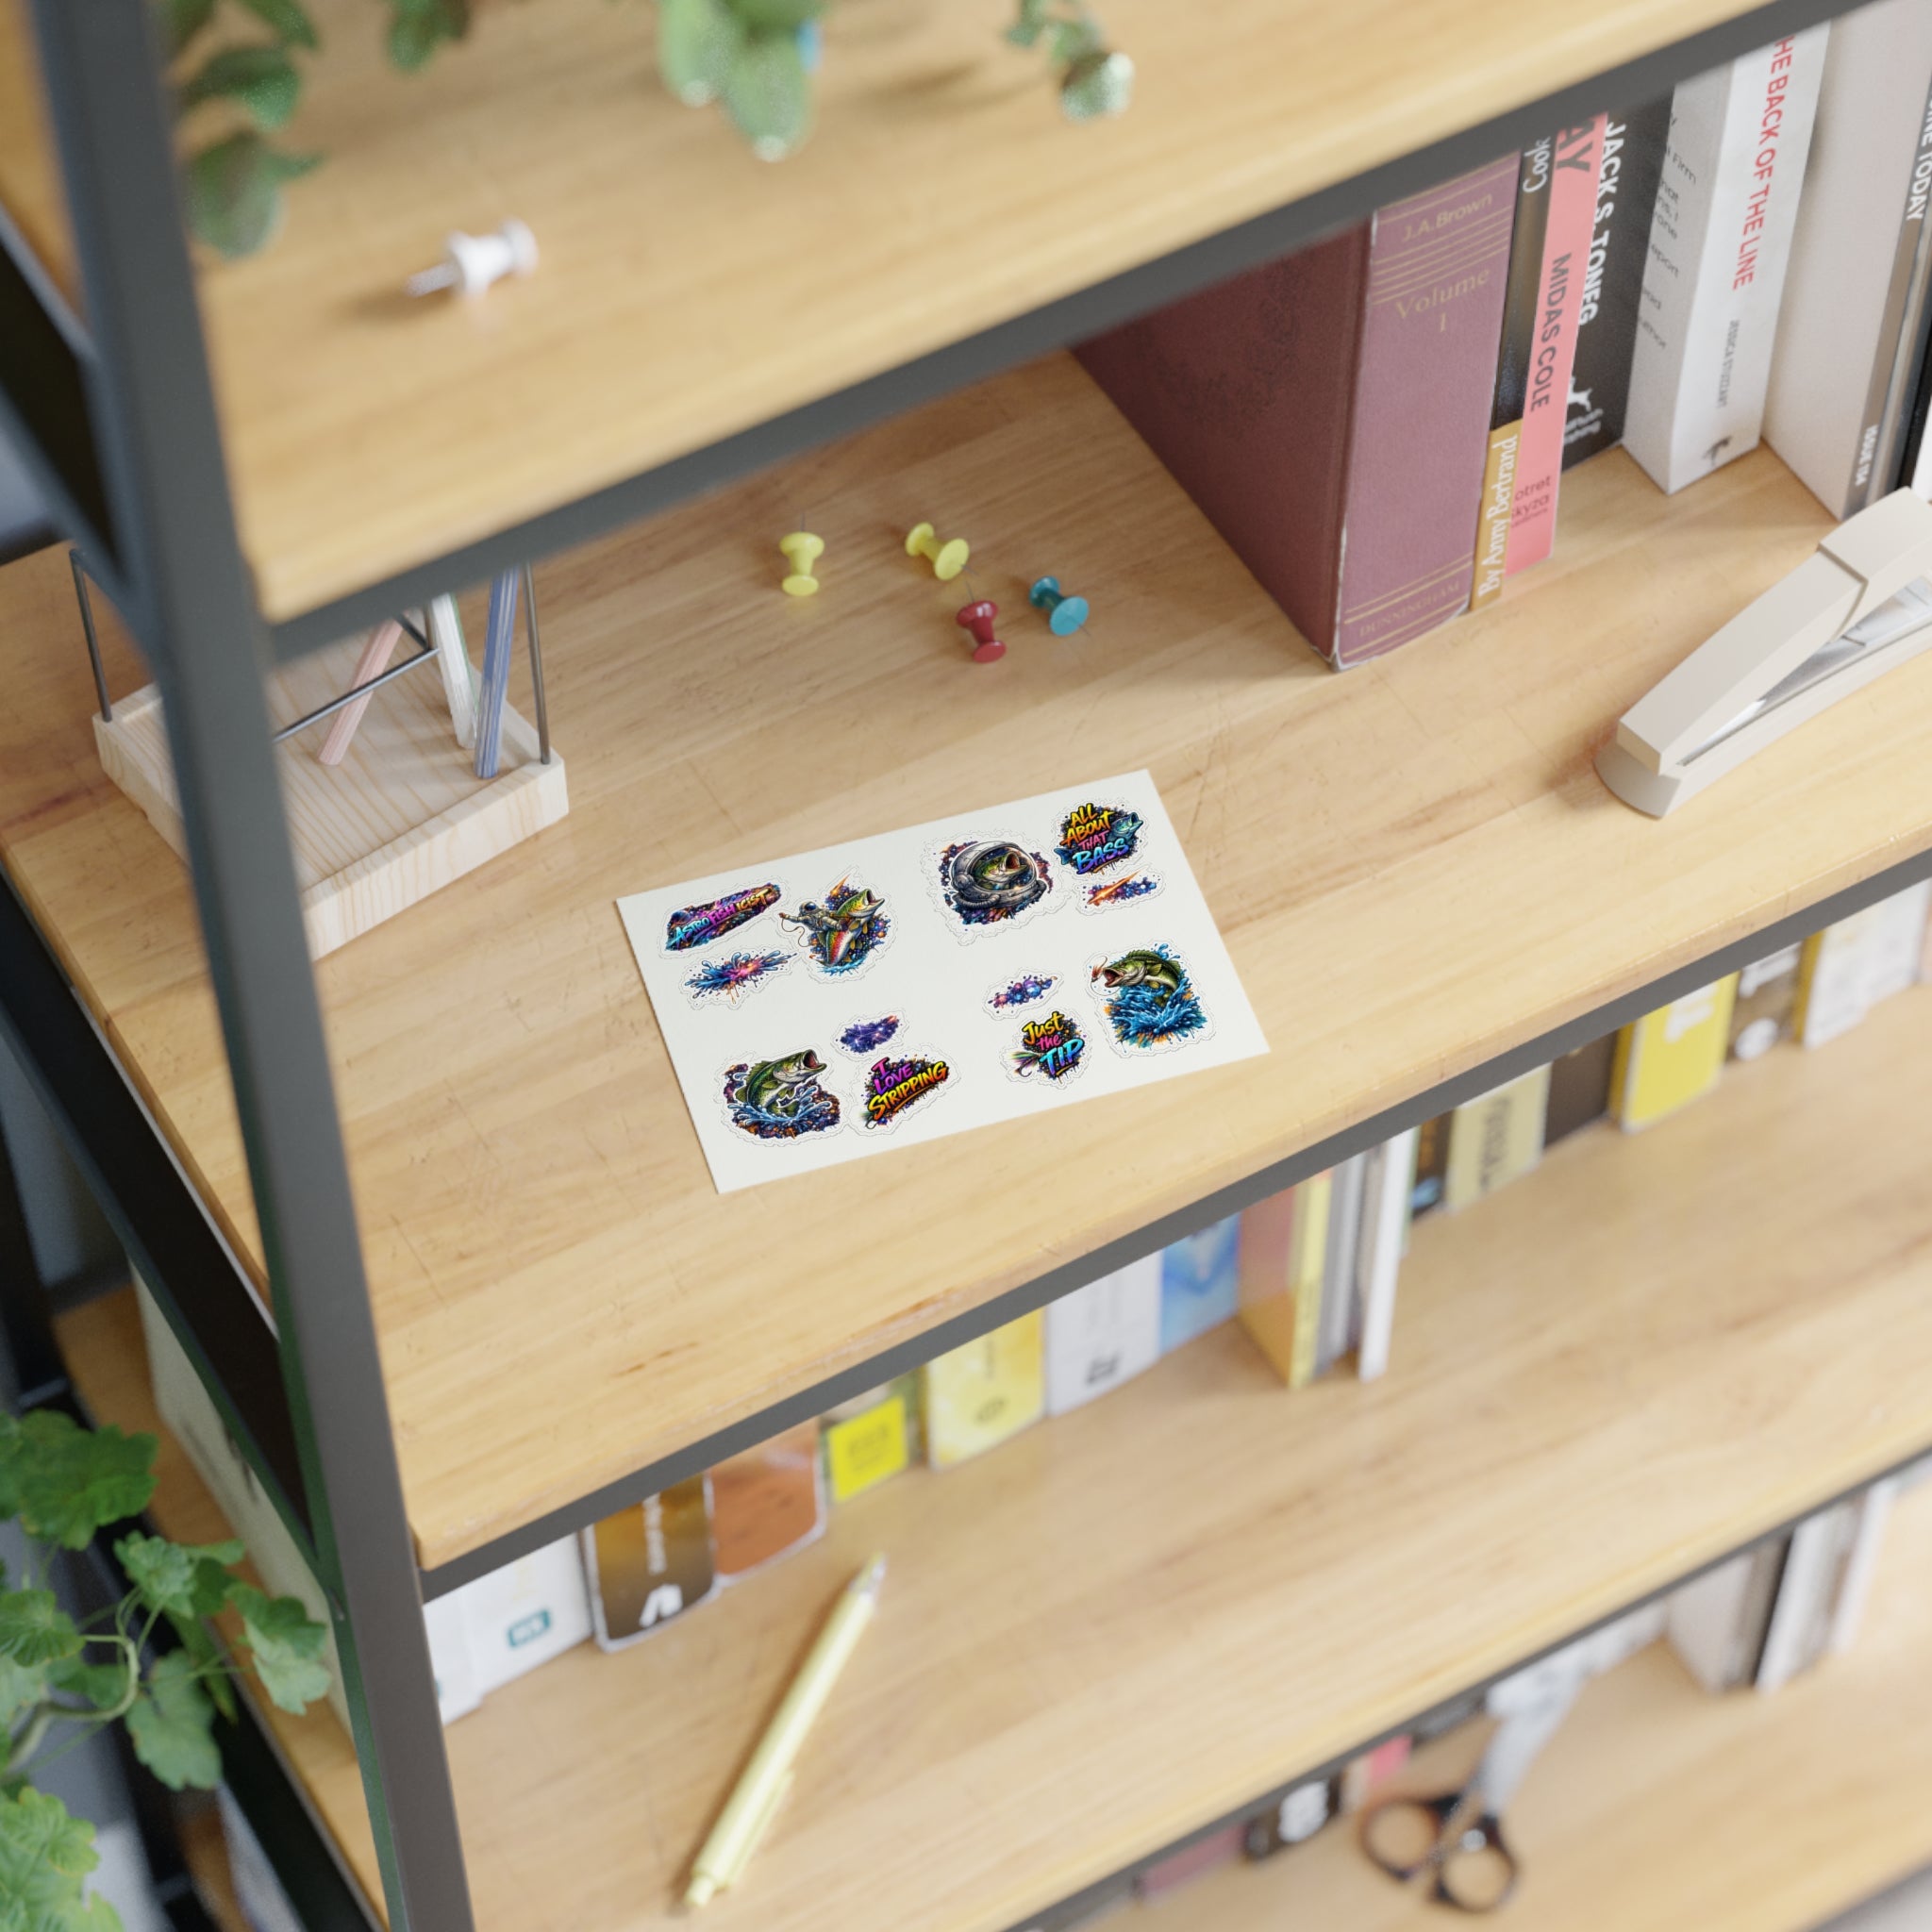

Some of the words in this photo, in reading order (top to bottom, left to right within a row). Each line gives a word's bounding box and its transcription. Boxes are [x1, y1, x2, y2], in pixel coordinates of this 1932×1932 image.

[1758, 75, 1789, 144] BACK
[1596, 122, 1626, 199] JACK
[1753, 147, 1776, 181] OF
[1906, 150, 1932, 221] TODAY
[1743, 184, 1770, 236] THE
[1732, 236, 1761, 291] LINE
[1395, 269, 1491, 320] Volume
[1541, 252, 1573, 343] MIDAS
[1530, 346, 1557, 413] COLE
[1486, 433, 1519, 520] Bertrand
[1477, 569, 1505, 598] By
[1059, 810, 1115, 848] ABOUT
[1070, 803, 1098, 828] ALL
[1072, 838, 1130, 874] BASS
[1078, 830, 1110, 851] THAT
[1022, 1011, 1065, 1045] Just
[871, 1056, 891, 1081] I
[874, 1062, 914, 1094] LOVE
[1039, 1039, 1085, 1075] TIP
[867, 1061, 949, 1121] STRIPPING
